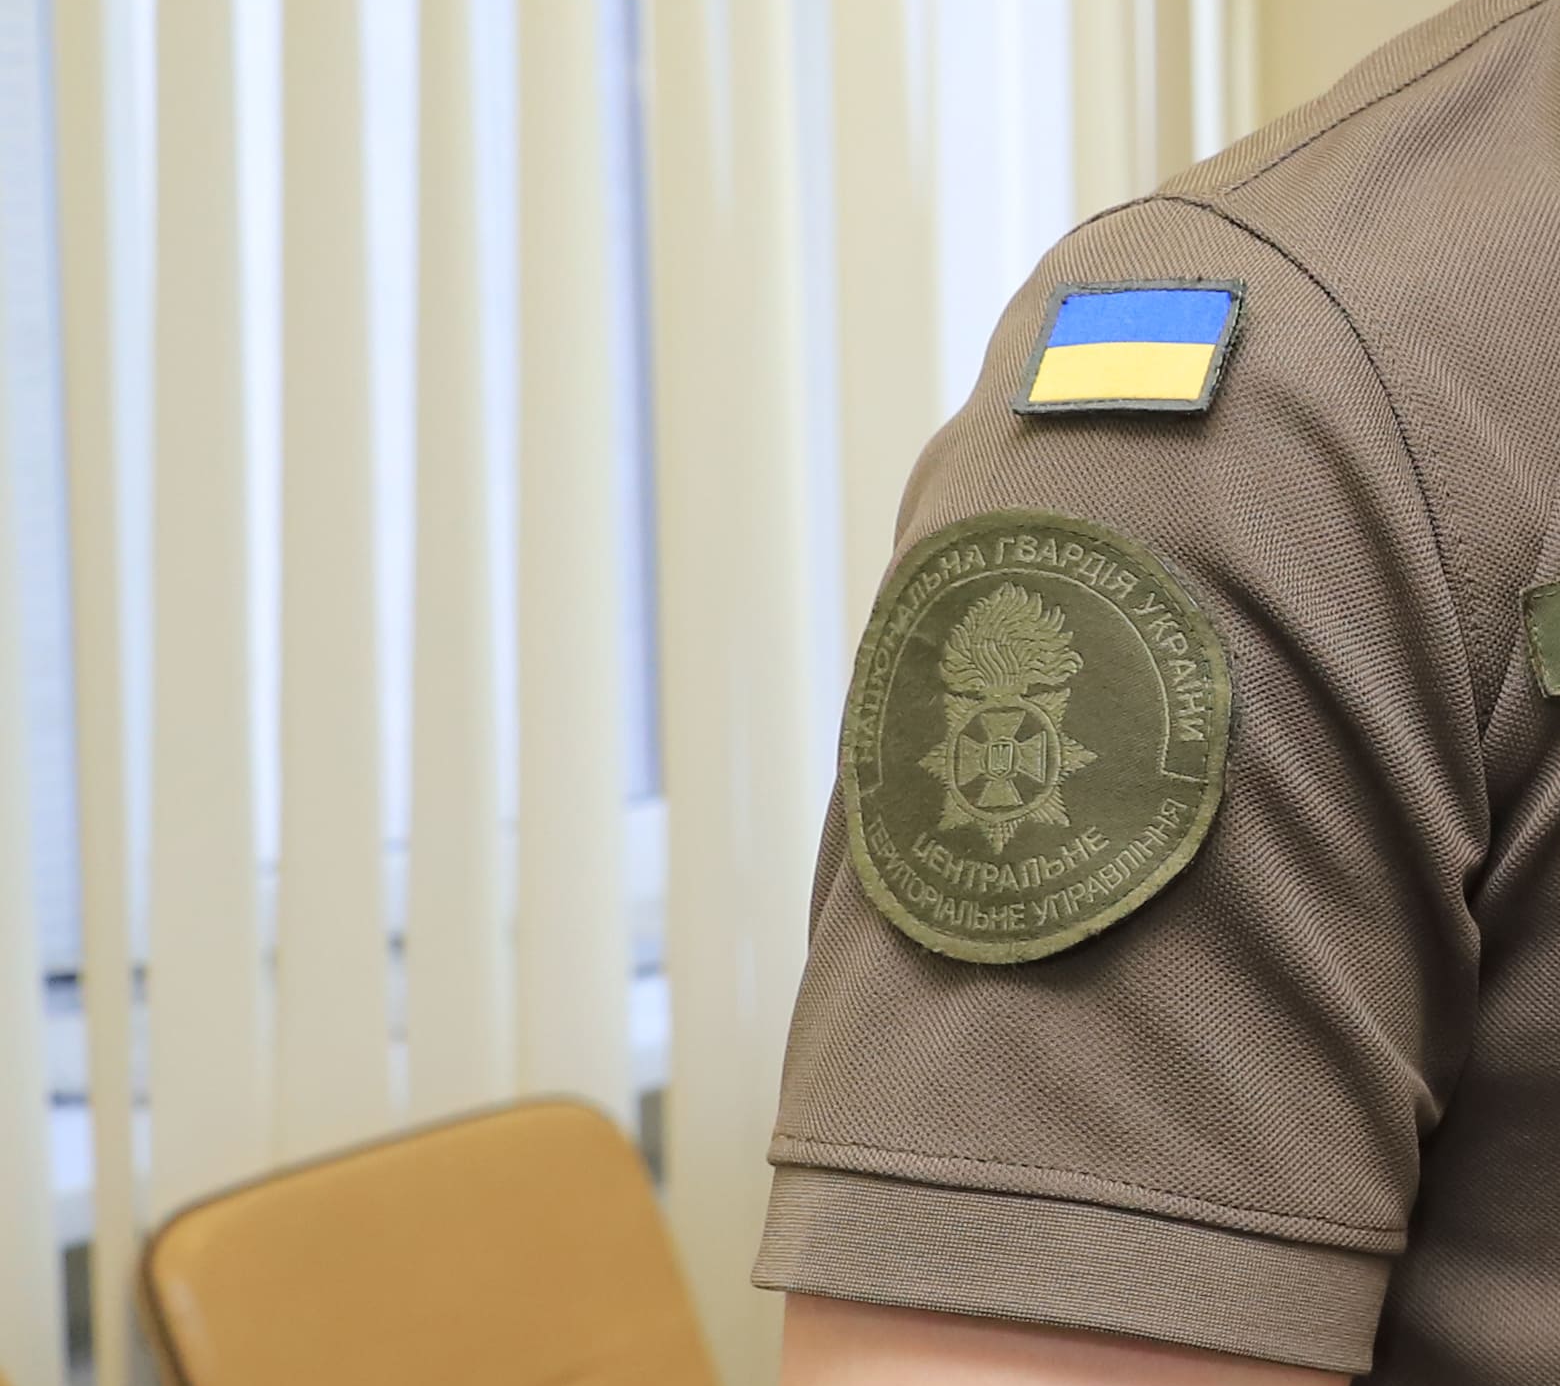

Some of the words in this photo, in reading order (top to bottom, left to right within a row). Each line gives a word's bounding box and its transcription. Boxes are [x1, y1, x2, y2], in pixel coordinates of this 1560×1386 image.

[997, 534, 1141, 599] ГВАРДІЯ
[1132, 592, 1206, 742] УКРАЇНИ
[867, 813, 1026, 931] ТЕРИТОРІАЛЬНЕ
[1031, 797, 1189, 926] УПРАВЛІННЯ
[911, 825, 1111, 894] ЦЕНТРАЛЬНЕ
